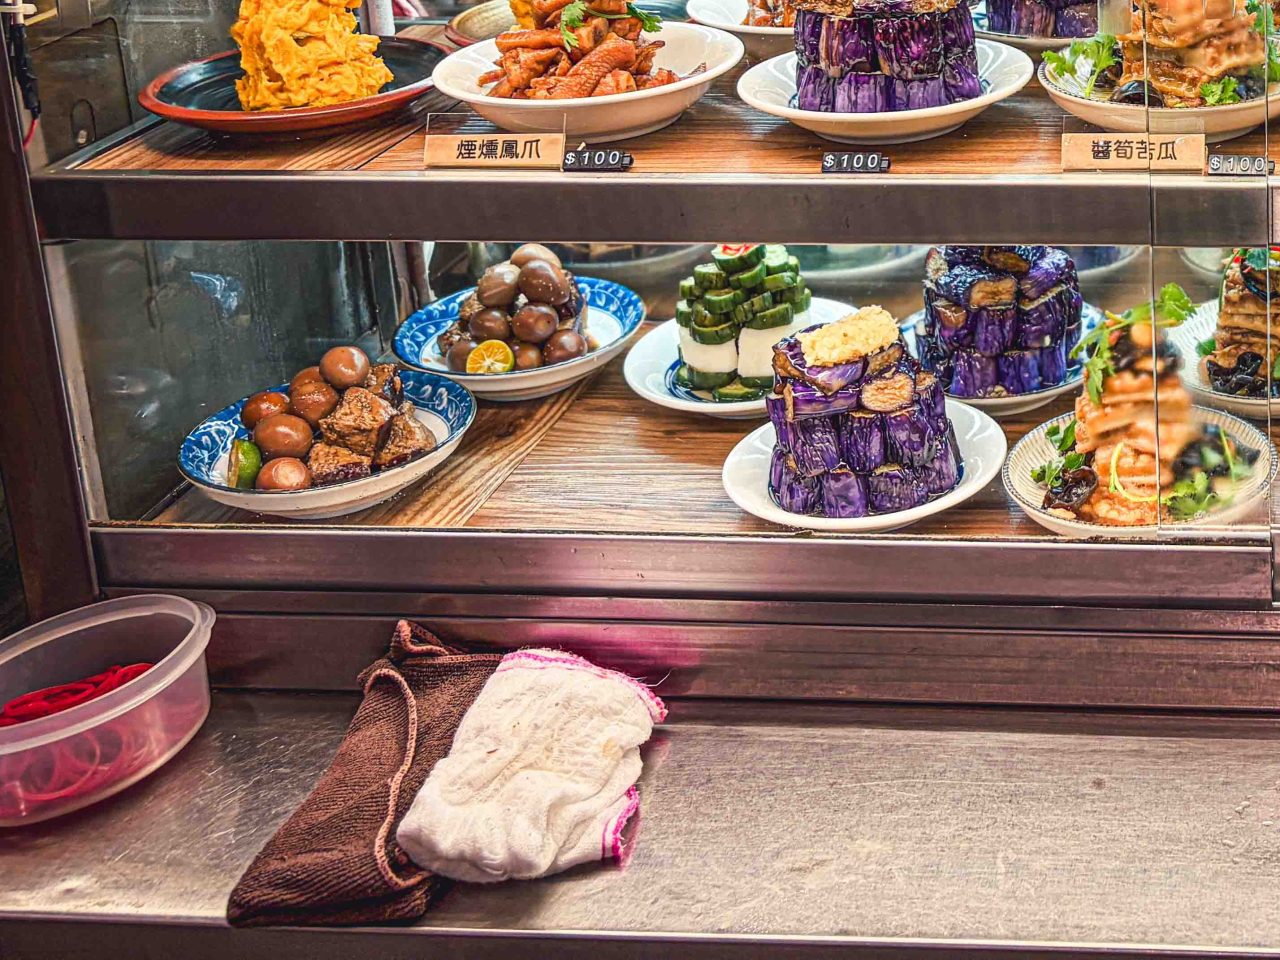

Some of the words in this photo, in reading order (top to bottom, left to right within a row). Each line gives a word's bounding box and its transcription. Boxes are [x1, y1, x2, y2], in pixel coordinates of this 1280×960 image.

[456, 139, 541, 160] 煙燻鳳爪
[1091, 139, 1177, 161] 醬筍苦瓜
[565, 151, 620, 165] $100
[823, 154, 878, 168] $100
[1210, 157, 1265, 171] $100
